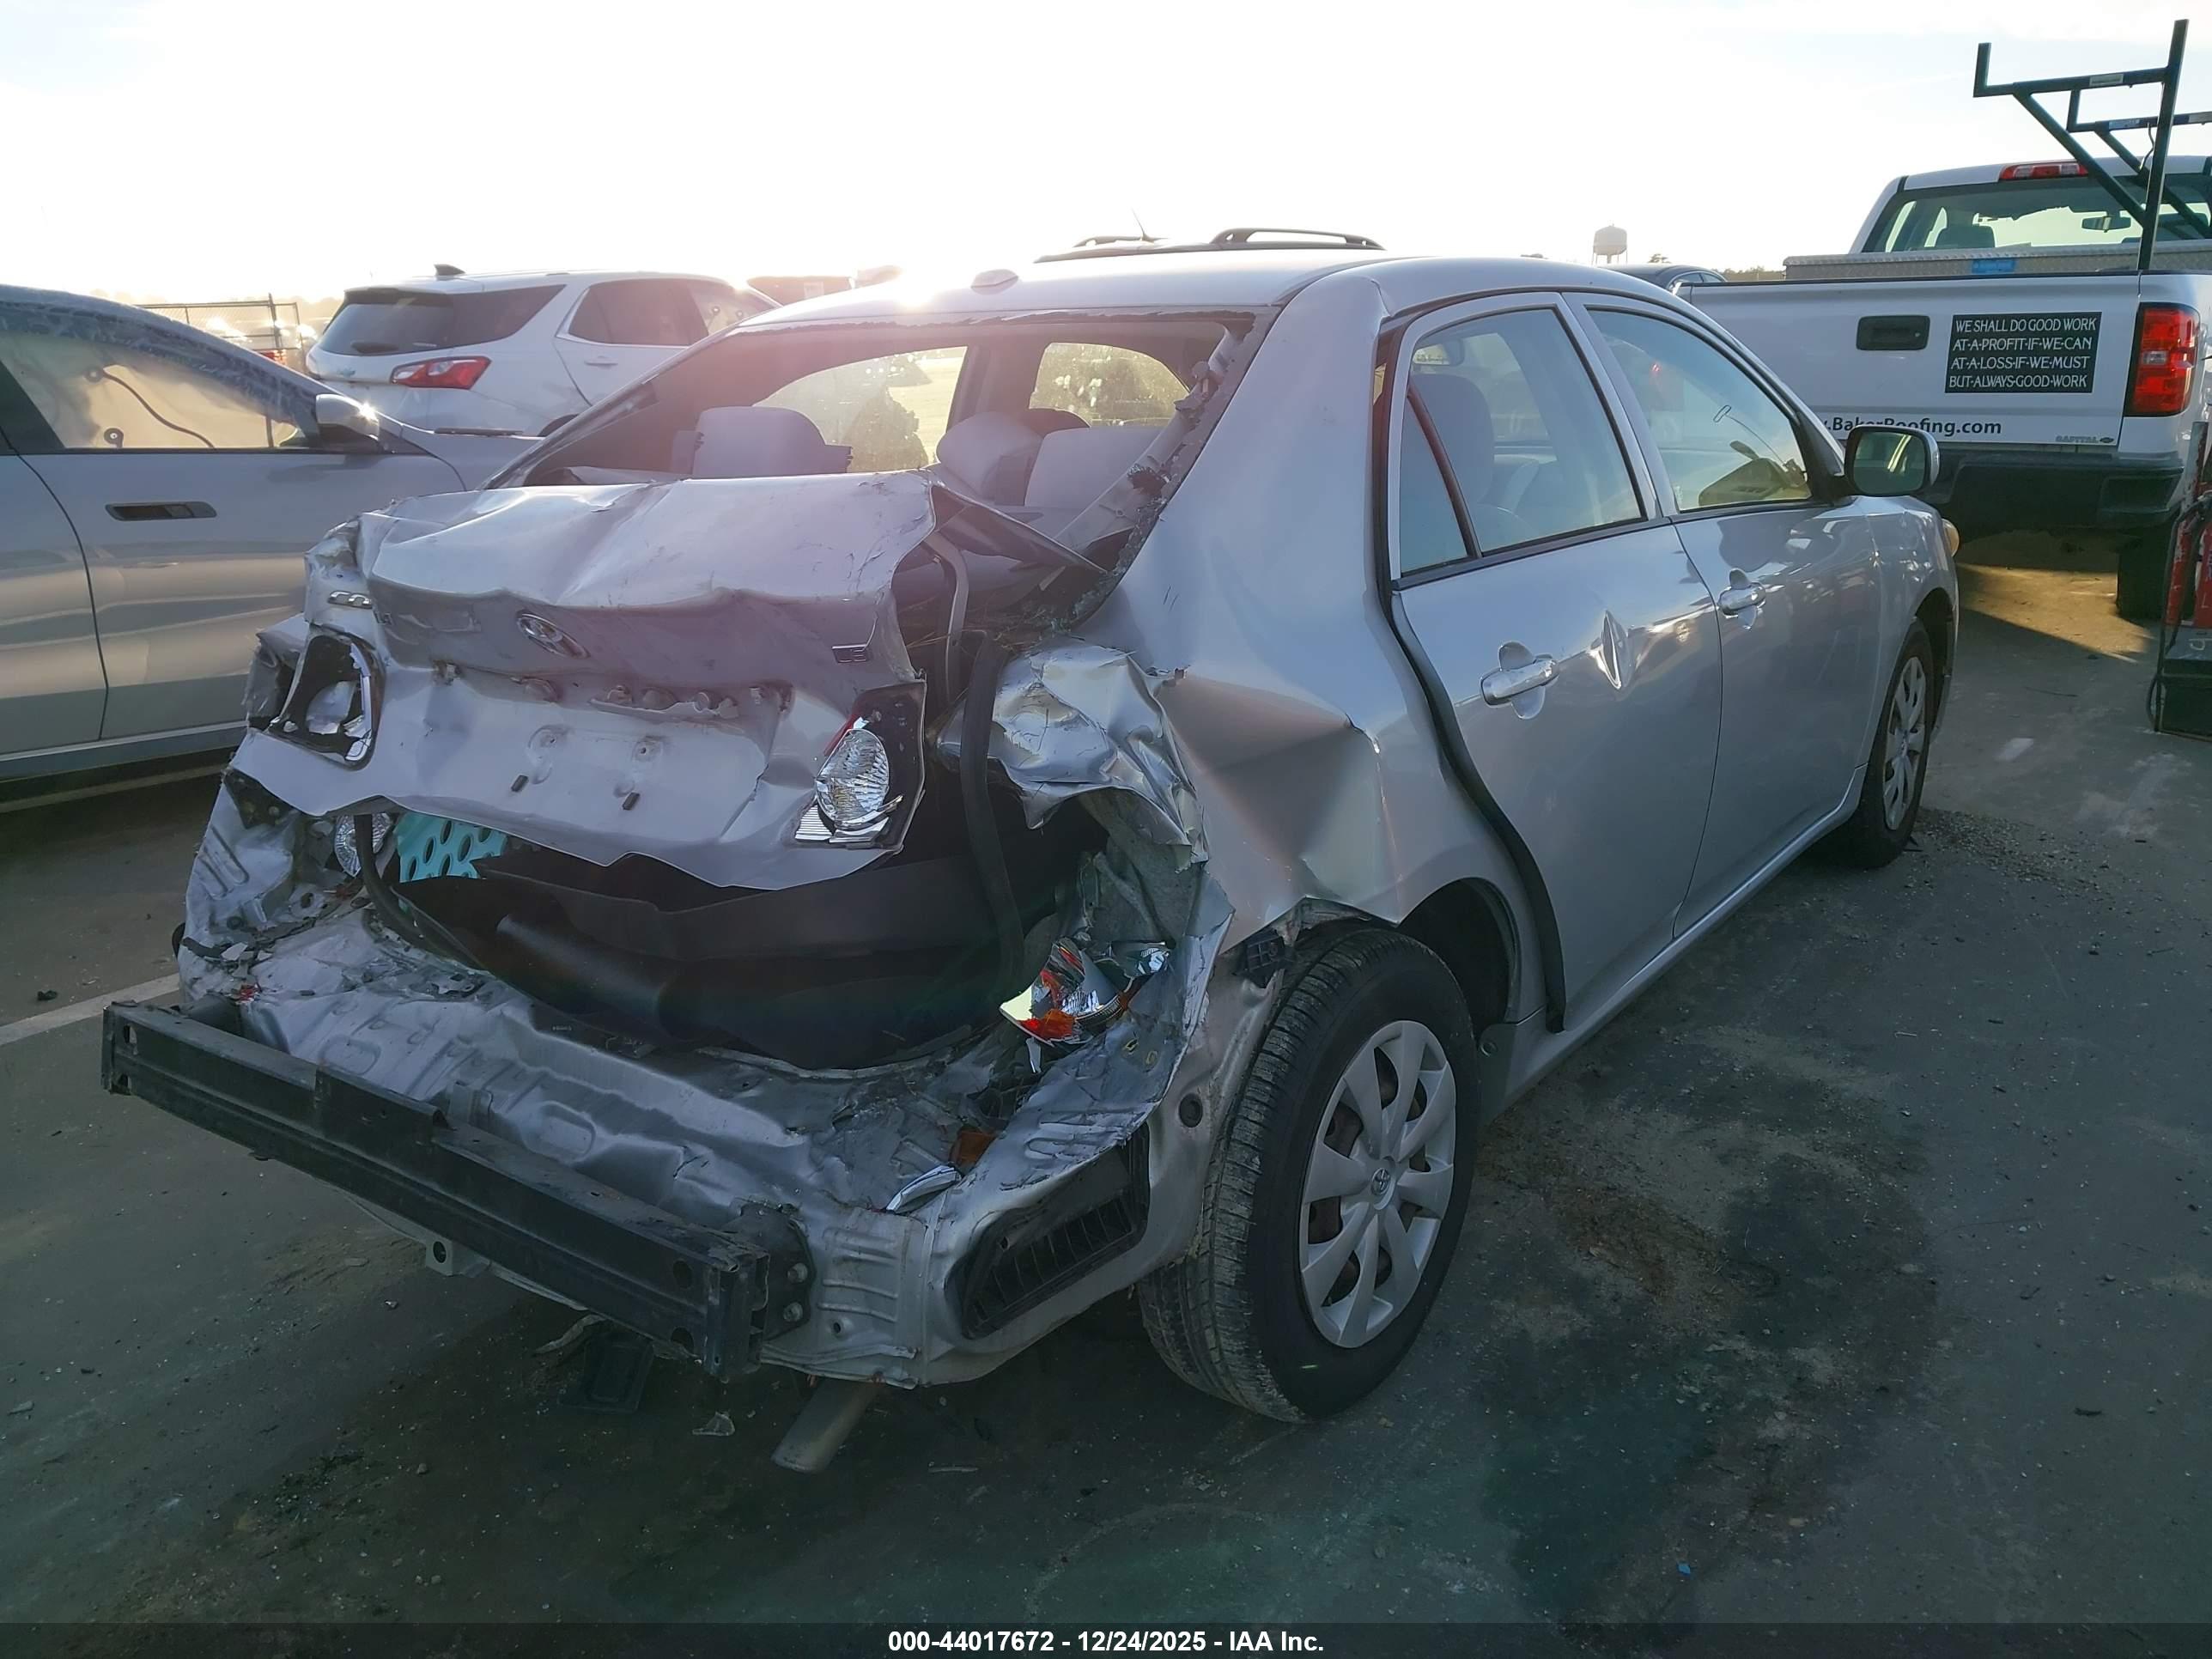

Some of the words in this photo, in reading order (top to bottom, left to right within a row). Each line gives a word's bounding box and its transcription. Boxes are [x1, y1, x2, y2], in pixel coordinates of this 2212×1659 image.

[1956, 319, 1972, 333] WE
[1973, 319, 2008, 332] SHALL
[2009, 319, 2027, 331] DO
[2028, 319, 2061, 331] GOOD
[2063, 318, 2097, 331] WORK
